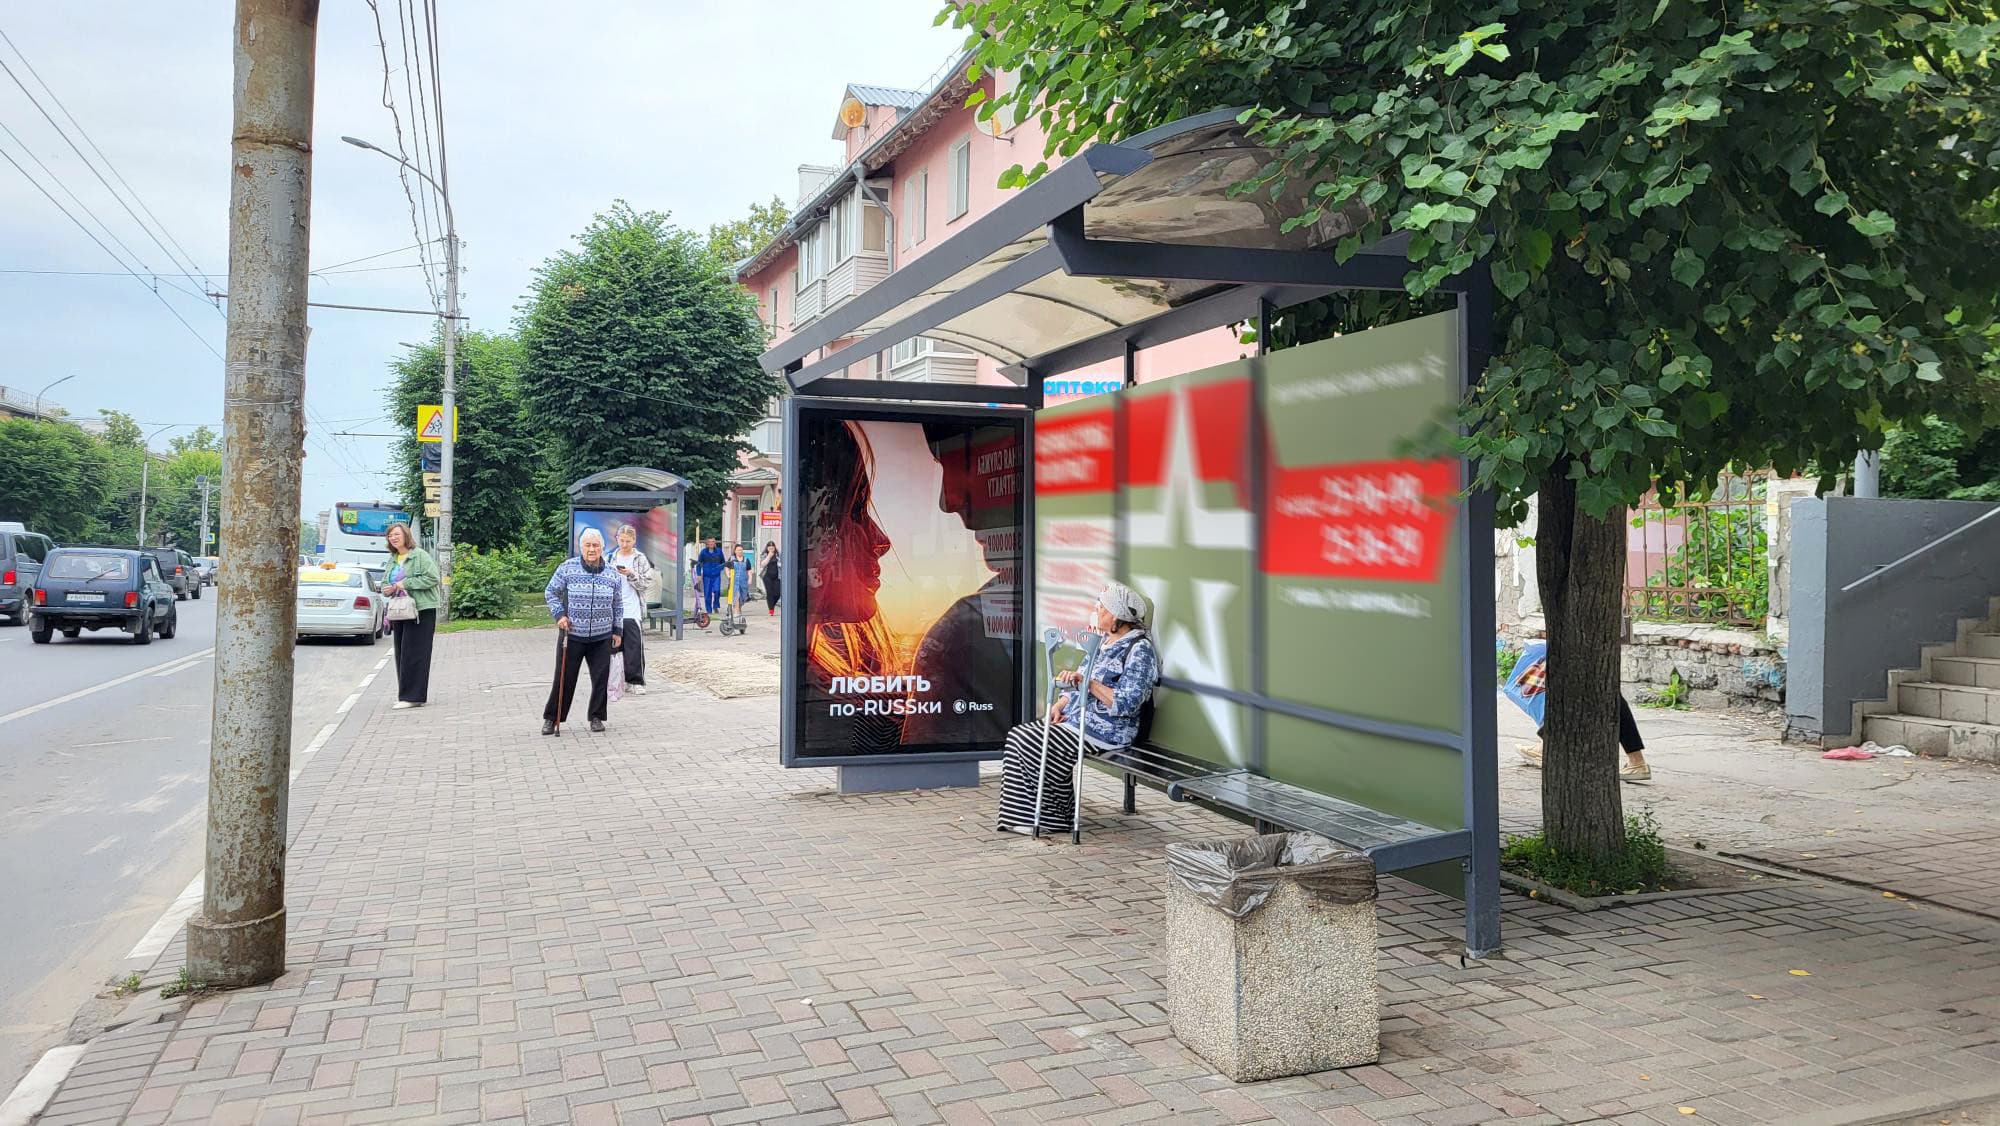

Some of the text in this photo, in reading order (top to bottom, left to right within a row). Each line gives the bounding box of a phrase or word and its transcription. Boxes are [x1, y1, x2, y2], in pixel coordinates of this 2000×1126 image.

[1044, 381, 1121, 395] аптека
[829, 675, 931, 694] ЛЮБИТЬ
[829, 698, 942, 716] по-RUSSки
[969, 701, 994, 711] Russ
